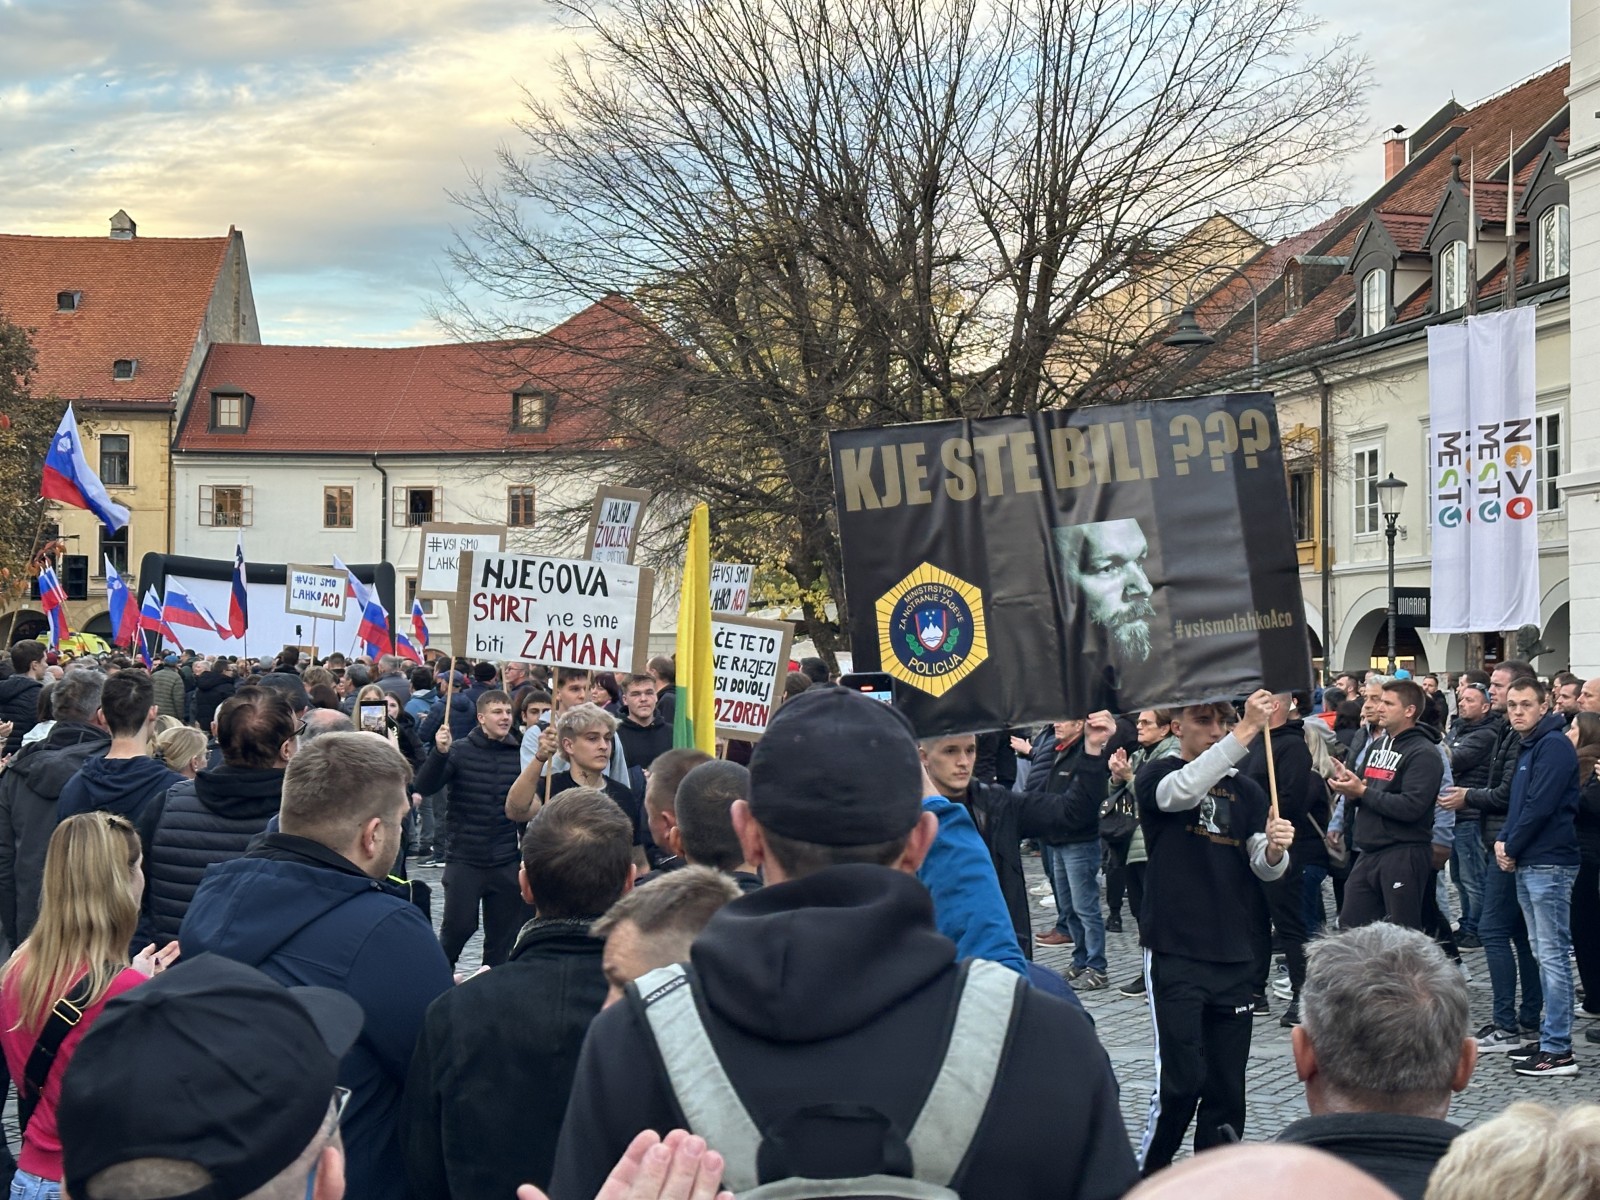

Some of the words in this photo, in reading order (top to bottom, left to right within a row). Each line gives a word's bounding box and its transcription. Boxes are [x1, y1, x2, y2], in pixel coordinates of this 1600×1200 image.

[839, 441, 932, 512] KJE
[940, 430, 1042, 501] STE
[1050, 418, 1159, 489] BILI
[1169, 408, 1271, 476] ???
[1503, 418, 1533, 520] NOVO
[1437, 431, 1462, 528] MESTO
[1478, 423, 1501, 523] MESTO
[428, 537, 456, 552] #VSI
[460, 538, 478, 551] SMO
[295, 575, 316, 586] #VSI
[320, 578, 336, 588] SMO
[481, 558, 609, 597] NJEGOVA
[712, 565, 733, 583] #VSI
[735, 566, 749, 583] SMO
[292, 589, 321, 600] LAHKO
[321, 593, 340, 608] ACO
[731, 588, 746, 611] ACO
[904, 584, 953, 603] MINISTRSTVO
[473, 592, 537, 623] SMRT
[547, 612, 574, 627] ne
[583, 613, 618, 629] sme
[902, 594, 939, 618] NOTRANJE
[940, 596, 964, 623] ZADEVE
[899, 618, 907, 631] ZA
[1174, 609, 1293, 639] #vsismolahkoAco
[476, 633, 503, 653] biti
[520, 629, 621, 668] ZAMAN
[714, 626, 737, 649] ČE
[731, 656, 777, 679] RAZJEZI
[908, 653, 963, 675] POLICIJA
[730, 678, 771, 702] DOVOLJ
[714, 697, 770, 727] OZOREN
